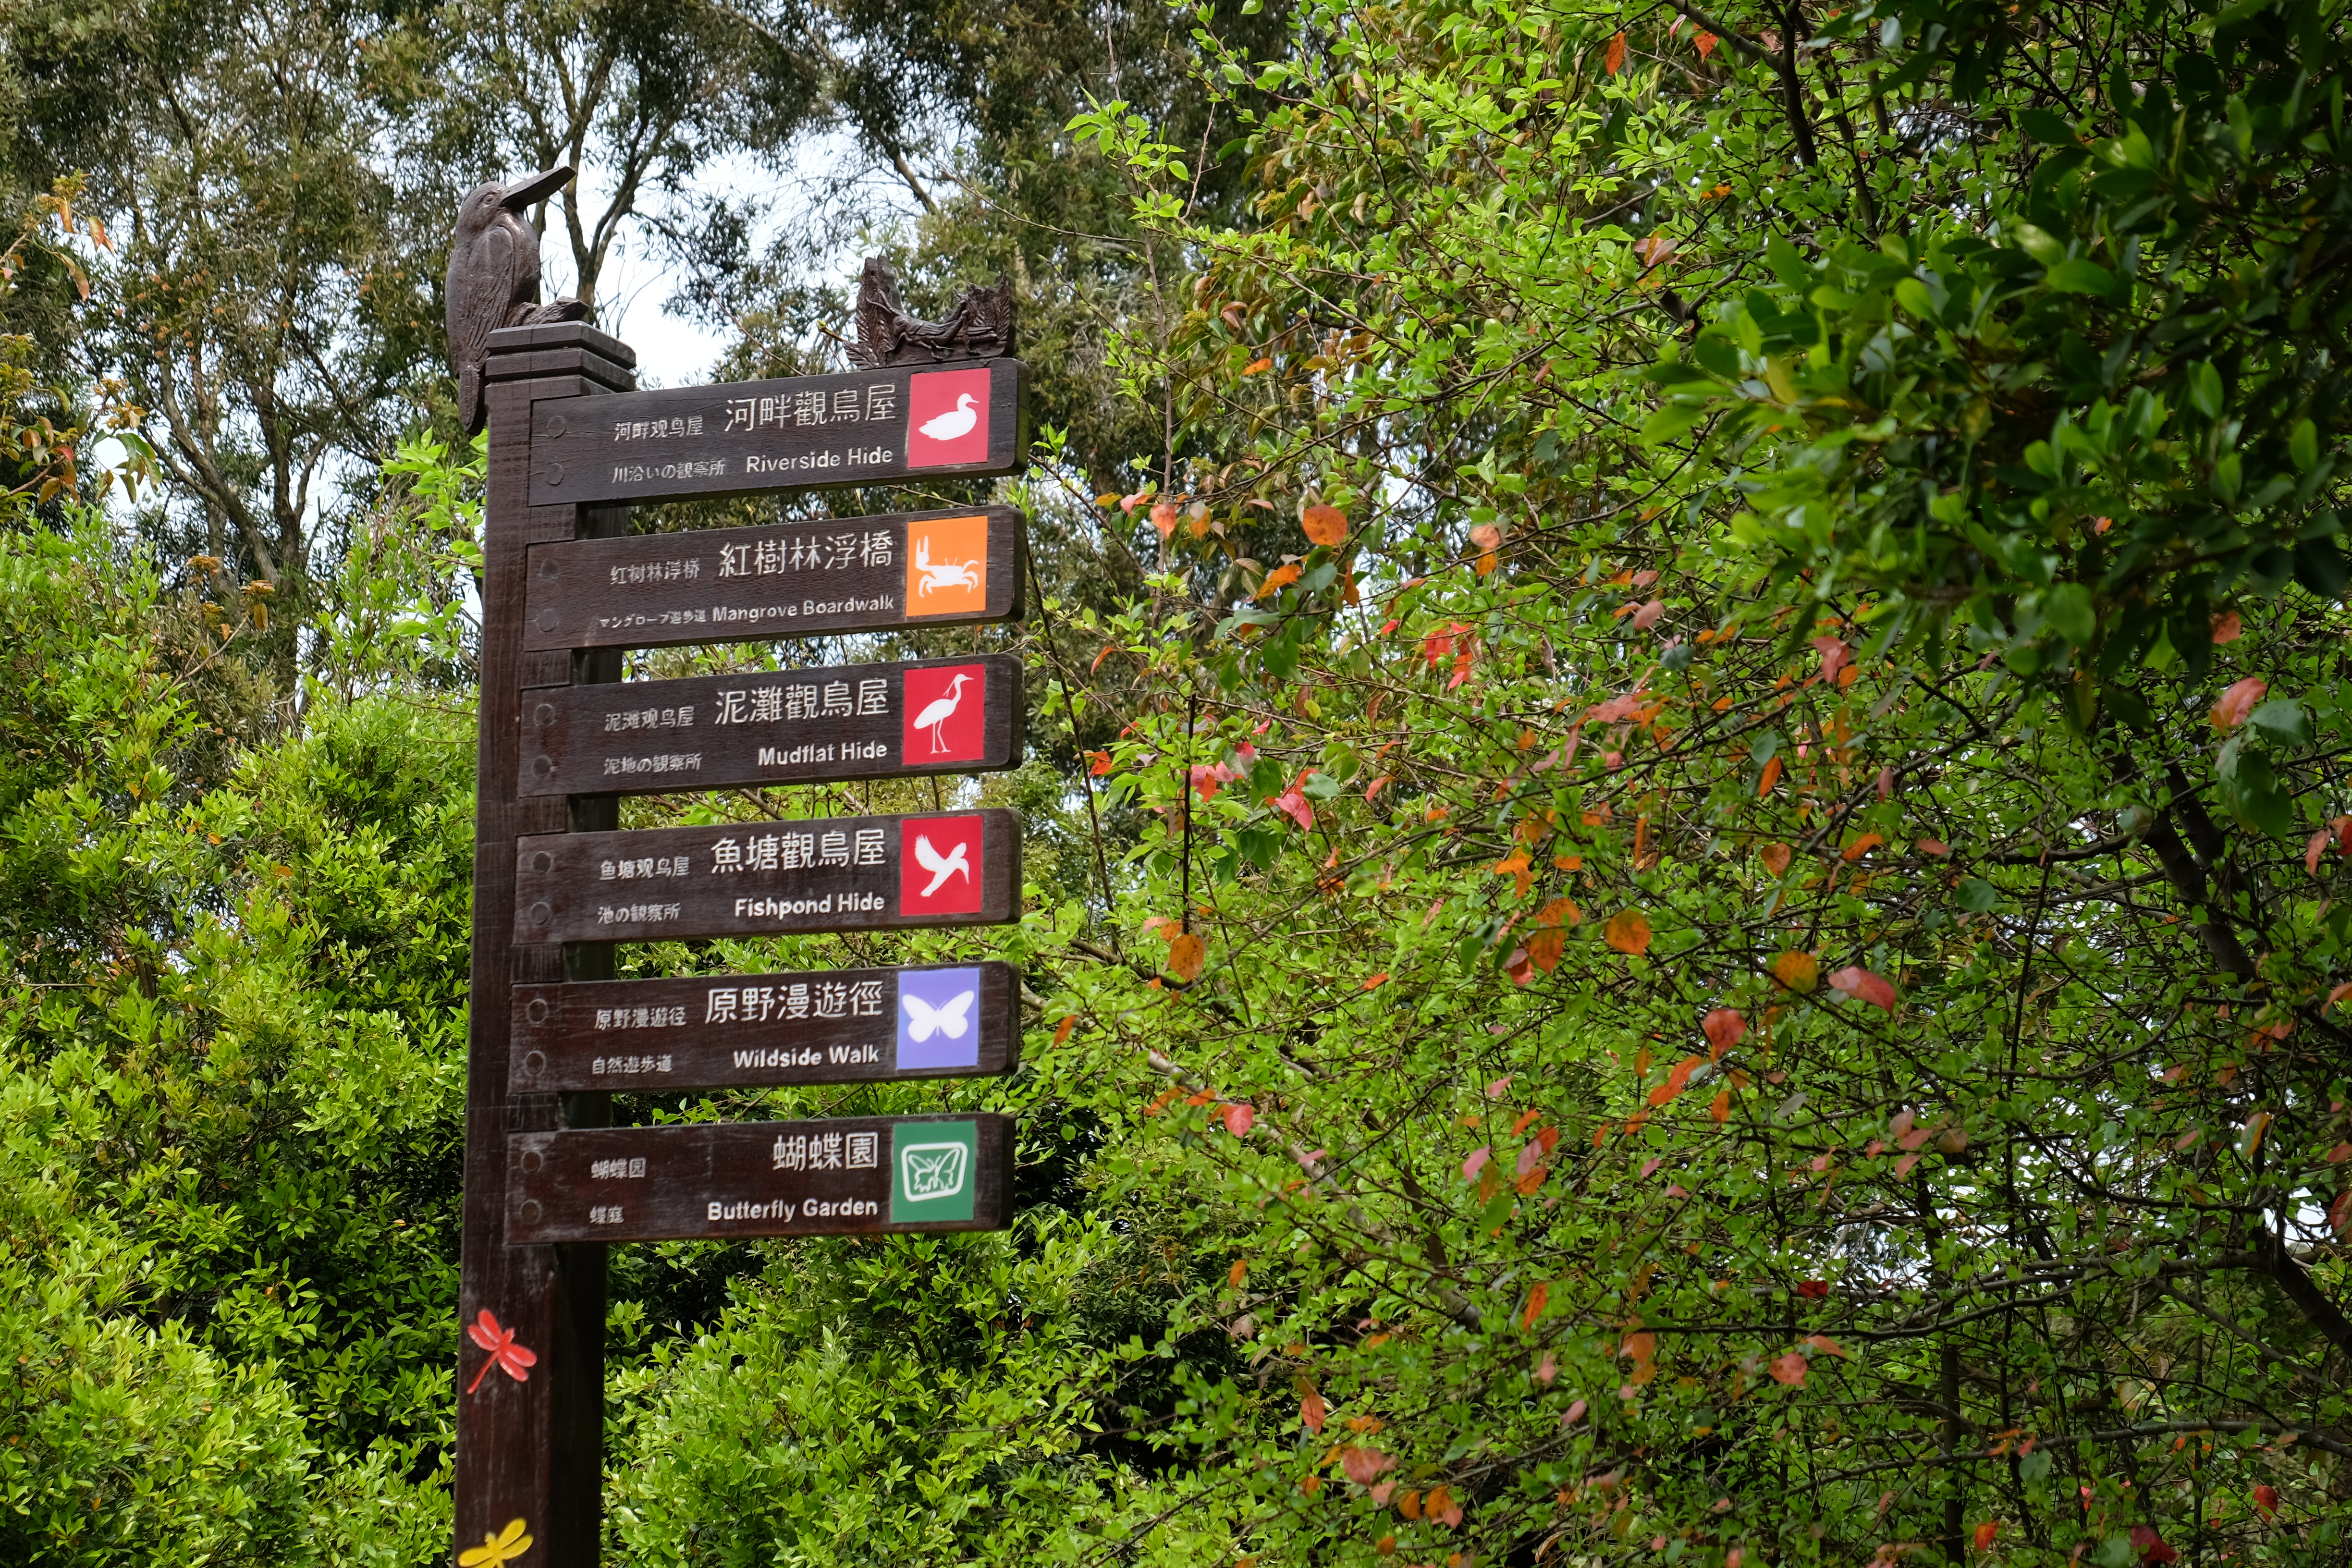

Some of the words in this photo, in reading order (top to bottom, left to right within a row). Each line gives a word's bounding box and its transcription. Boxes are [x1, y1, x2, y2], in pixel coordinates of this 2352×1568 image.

[724, 383, 896, 431] 河畔觀鳥屋
[614, 414, 704, 441] 河畔观鸟屋
[612, 457, 726, 483] 川沿いの観察所
[746, 450, 841, 473] Riverside
[847, 446, 893, 465] Hide
[719, 529, 894, 577] 紅樹林浮橋
[610, 557, 700, 585] 红树林浮桥
[712, 605, 798, 623] Mangrove
[803, 594, 894, 615] Boardwalk
[714, 678, 889, 725] 泥灘觀鳥屋
[604, 705, 695, 732] 泥滩观鸟屋
[603, 752, 703, 775] 泥地の観察所
[758, 743, 835, 766] Mudflat
[841, 740, 888, 761] Hide
[710, 828, 886, 874] 魚塘觀鳥屋
[599, 856, 690, 880] 鱼塘观鸟屋
[598, 902, 681, 924] 池の観察所
[734, 893, 832, 920] Fishpond
[837, 891, 885, 912] Hide
[704, 980, 883, 1024] 原野漫遊徑
[592, 1054, 673, 1075] 自然遊歩道
[733, 1047, 822, 1068] Wildside
[829, 1044, 880, 1065] Walk
[772, 1131, 879, 1172] 蝴蝶園
[591, 1157, 646, 1179] 蝴蝶园
[707, 1199, 796, 1223] Butterfly
[802, 1197, 878, 1217] Garden
